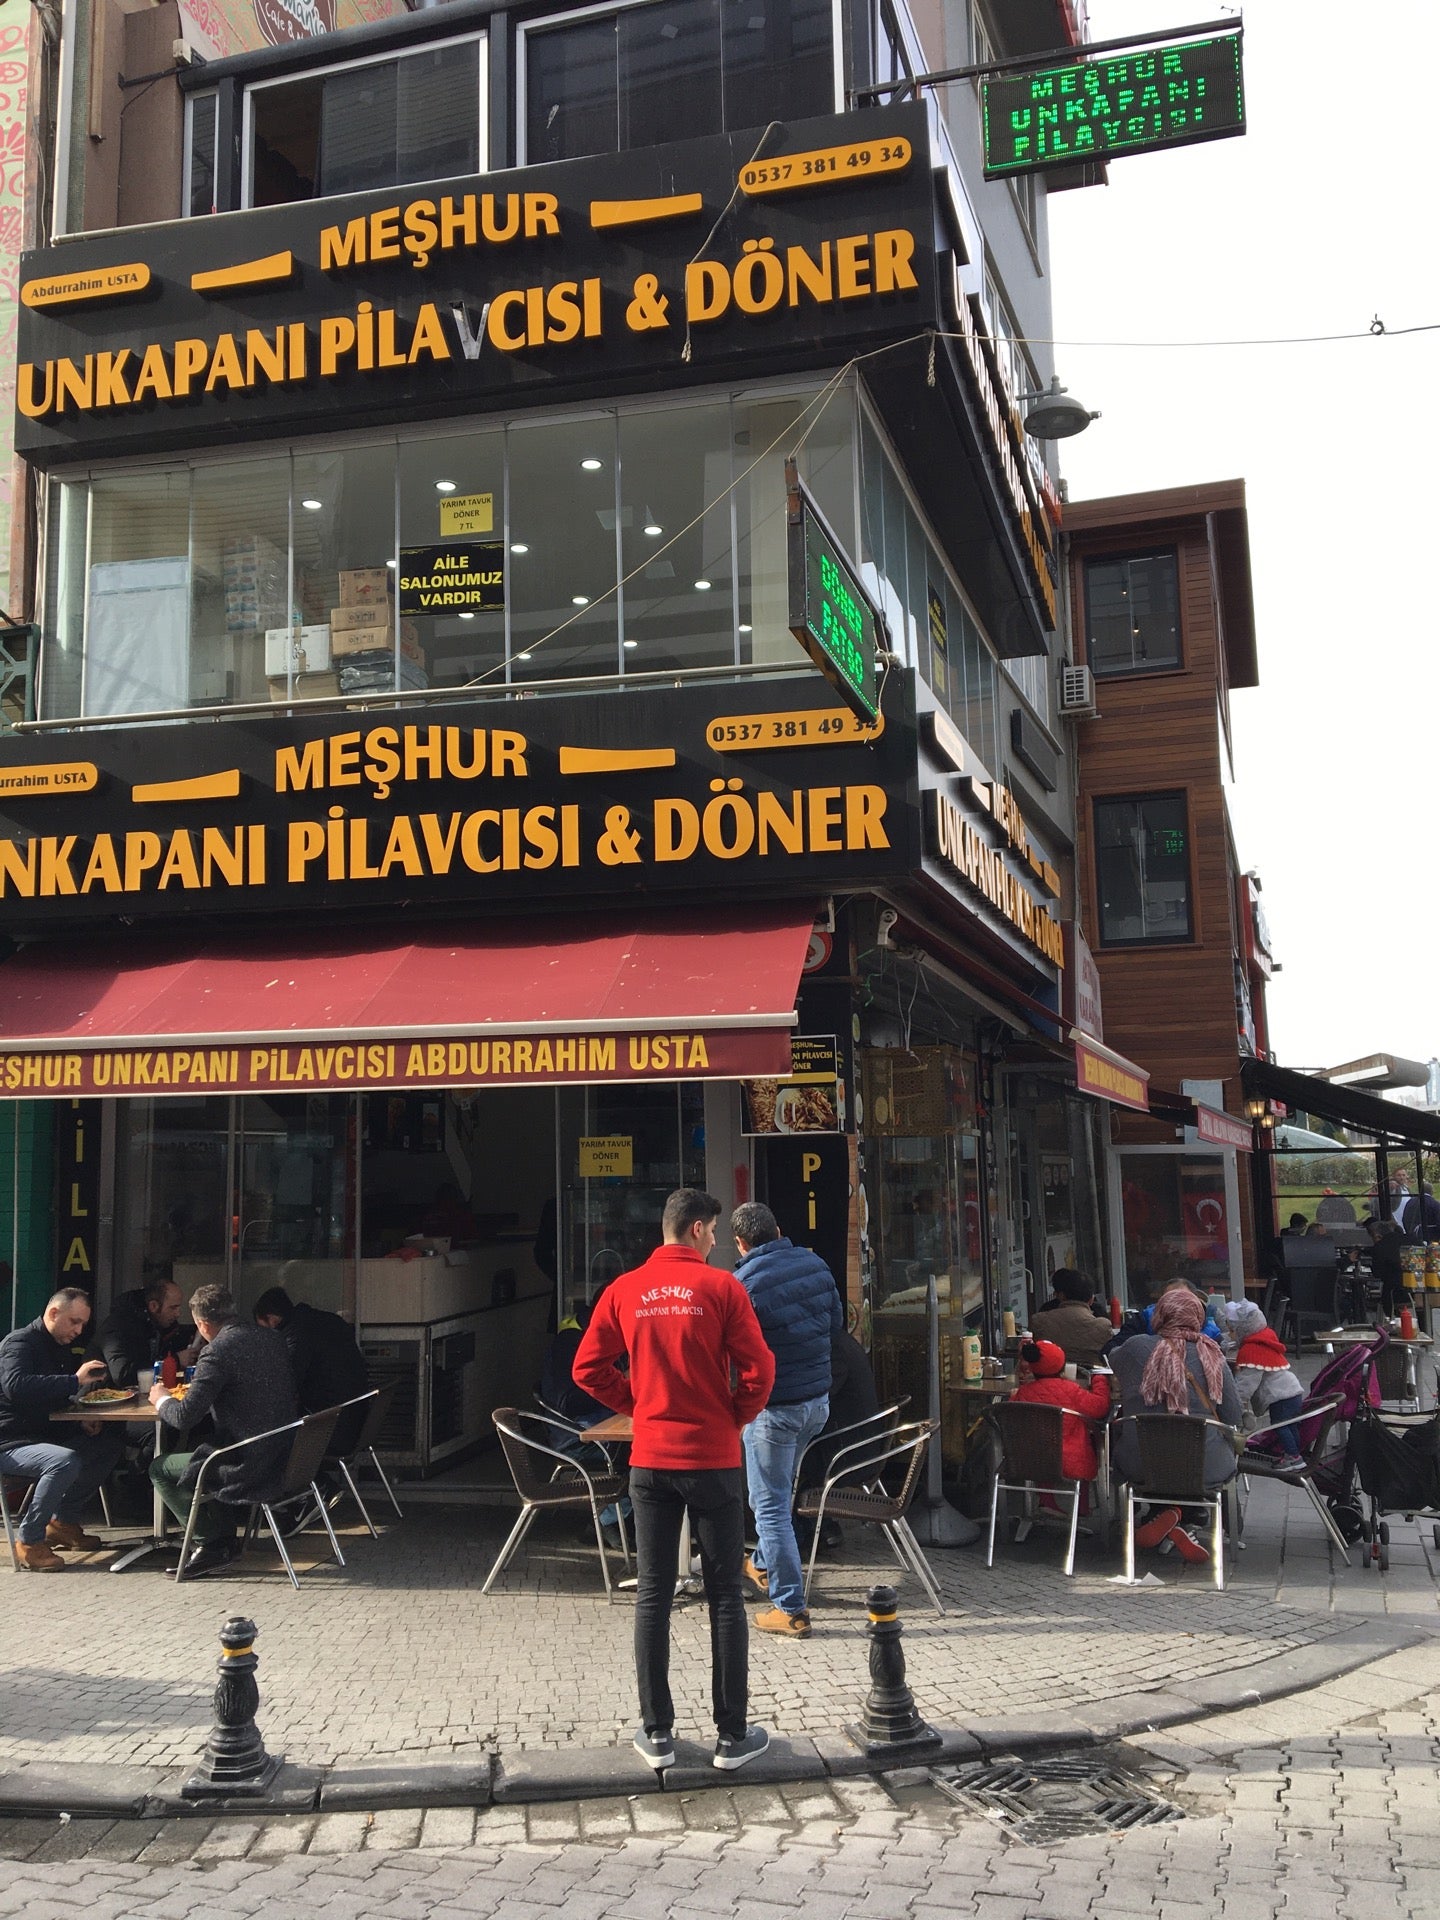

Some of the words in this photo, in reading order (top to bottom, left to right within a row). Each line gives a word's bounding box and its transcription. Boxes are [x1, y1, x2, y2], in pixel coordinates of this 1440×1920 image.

[745, 164, 793, 185] 0537
[802, 157, 836, 176] 381
[846, 150, 871, 168] 49
[879, 145, 905, 162] 34
[320, 192, 561, 270] MEŞHUR
[31, 279, 103, 298] Abdurrahim
[107, 272, 138, 287] USTA
[17, 321, 305, 417] UNKAPANI
[320, 278, 602, 375] PİLAVCISI
[626, 273, 669, 331] &
[685, 229, 918, 322] DÖNER
[442, 500, 466, 509] YARIM
[468, 497, 492, 506] TAVUK
[454, 509, 480, 519] DÖNER
[433, 553, 470, 570] AİLE
[400, 571, 503, 590] SALONUMUZ
[420, 591, 481, 606] VARDIR
[713, 724, 763, 742] 0537
[772, 721, 808, 738] 381
[818, 717, 844, 734] 49
[275, 725, 529, 800] MEŞHUR
[54, 772, 88, 784] USTA
[0, 824, 266, 898] NKAPANI
[288, 804, 580, 884] PİLAVCISI
[596, 805, 641, 866] &
[655, 777, 891, 862] DÖNER
[791, 1041, 814, 1050] EŞHUR
[93, 1051, 240, 1086] UNKAPANI
[629, 1035, 710, 1071] USTA
[791, 1052, 801, 1060] NI
[792, 1062, 812, 1070] ÖNER
[592, 1151, 620, 1160] DÖNER
[641, 1286, 694, 1306] MEŞHUR
[635, 1306, 670, 1318] UNKAPANI
